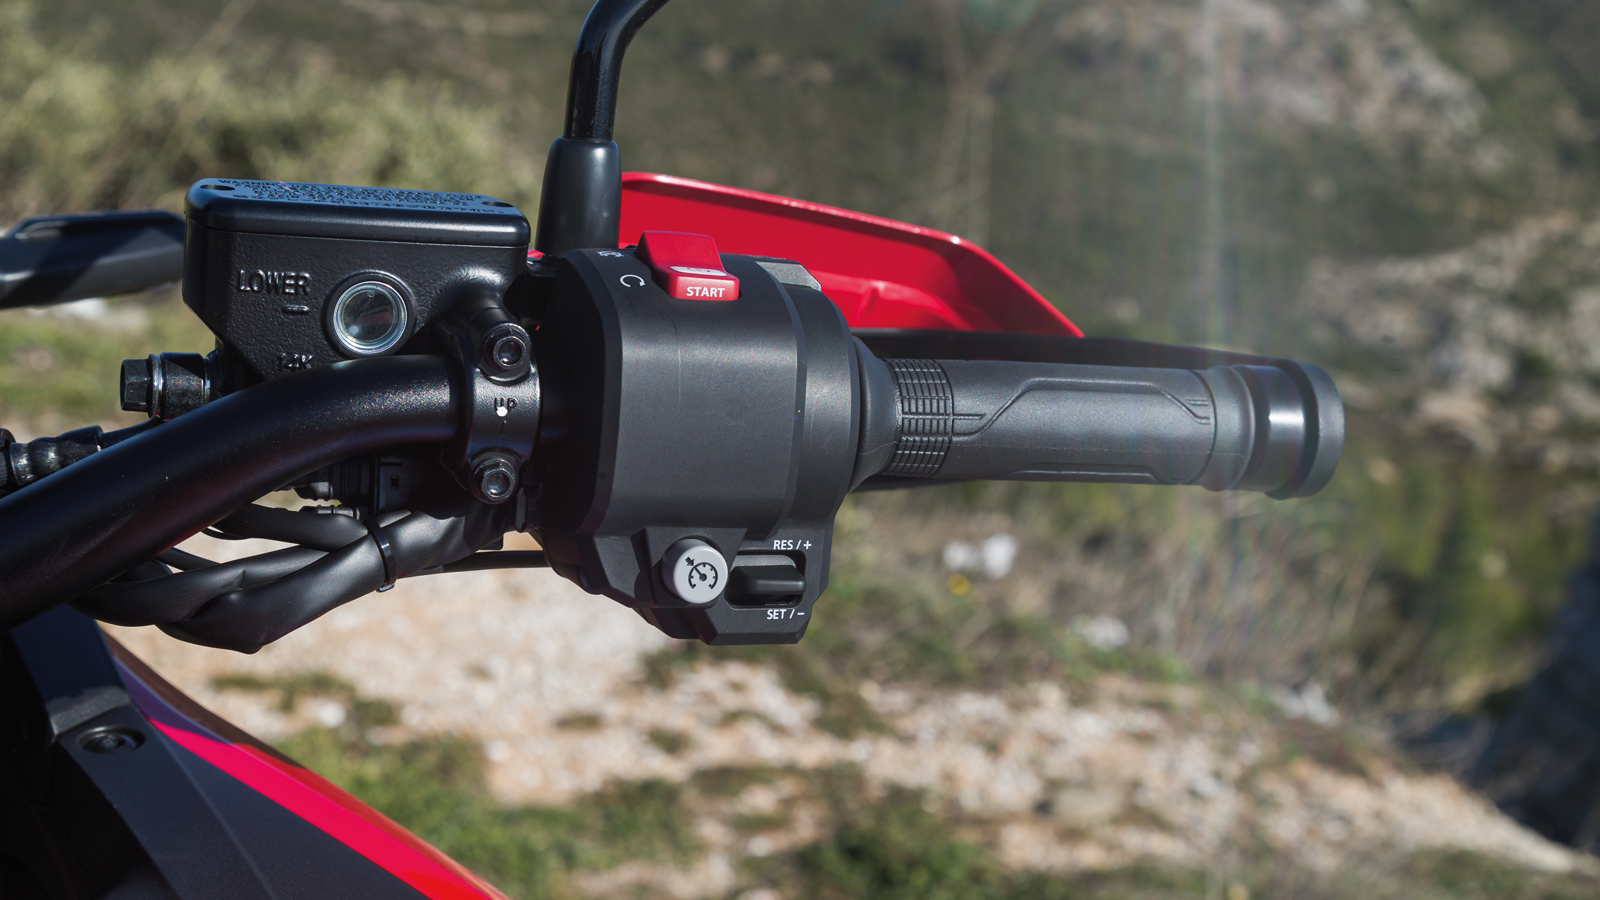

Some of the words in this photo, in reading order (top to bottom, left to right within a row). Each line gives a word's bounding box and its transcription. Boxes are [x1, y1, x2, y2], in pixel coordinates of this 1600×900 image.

[238, 269, 311, 295] LOWER
[686, 286, 725, 298] START
[494, 398, 518, 412] UP
[773, 540, 793, 550] RES
[767, 609, 787, 619] SET
